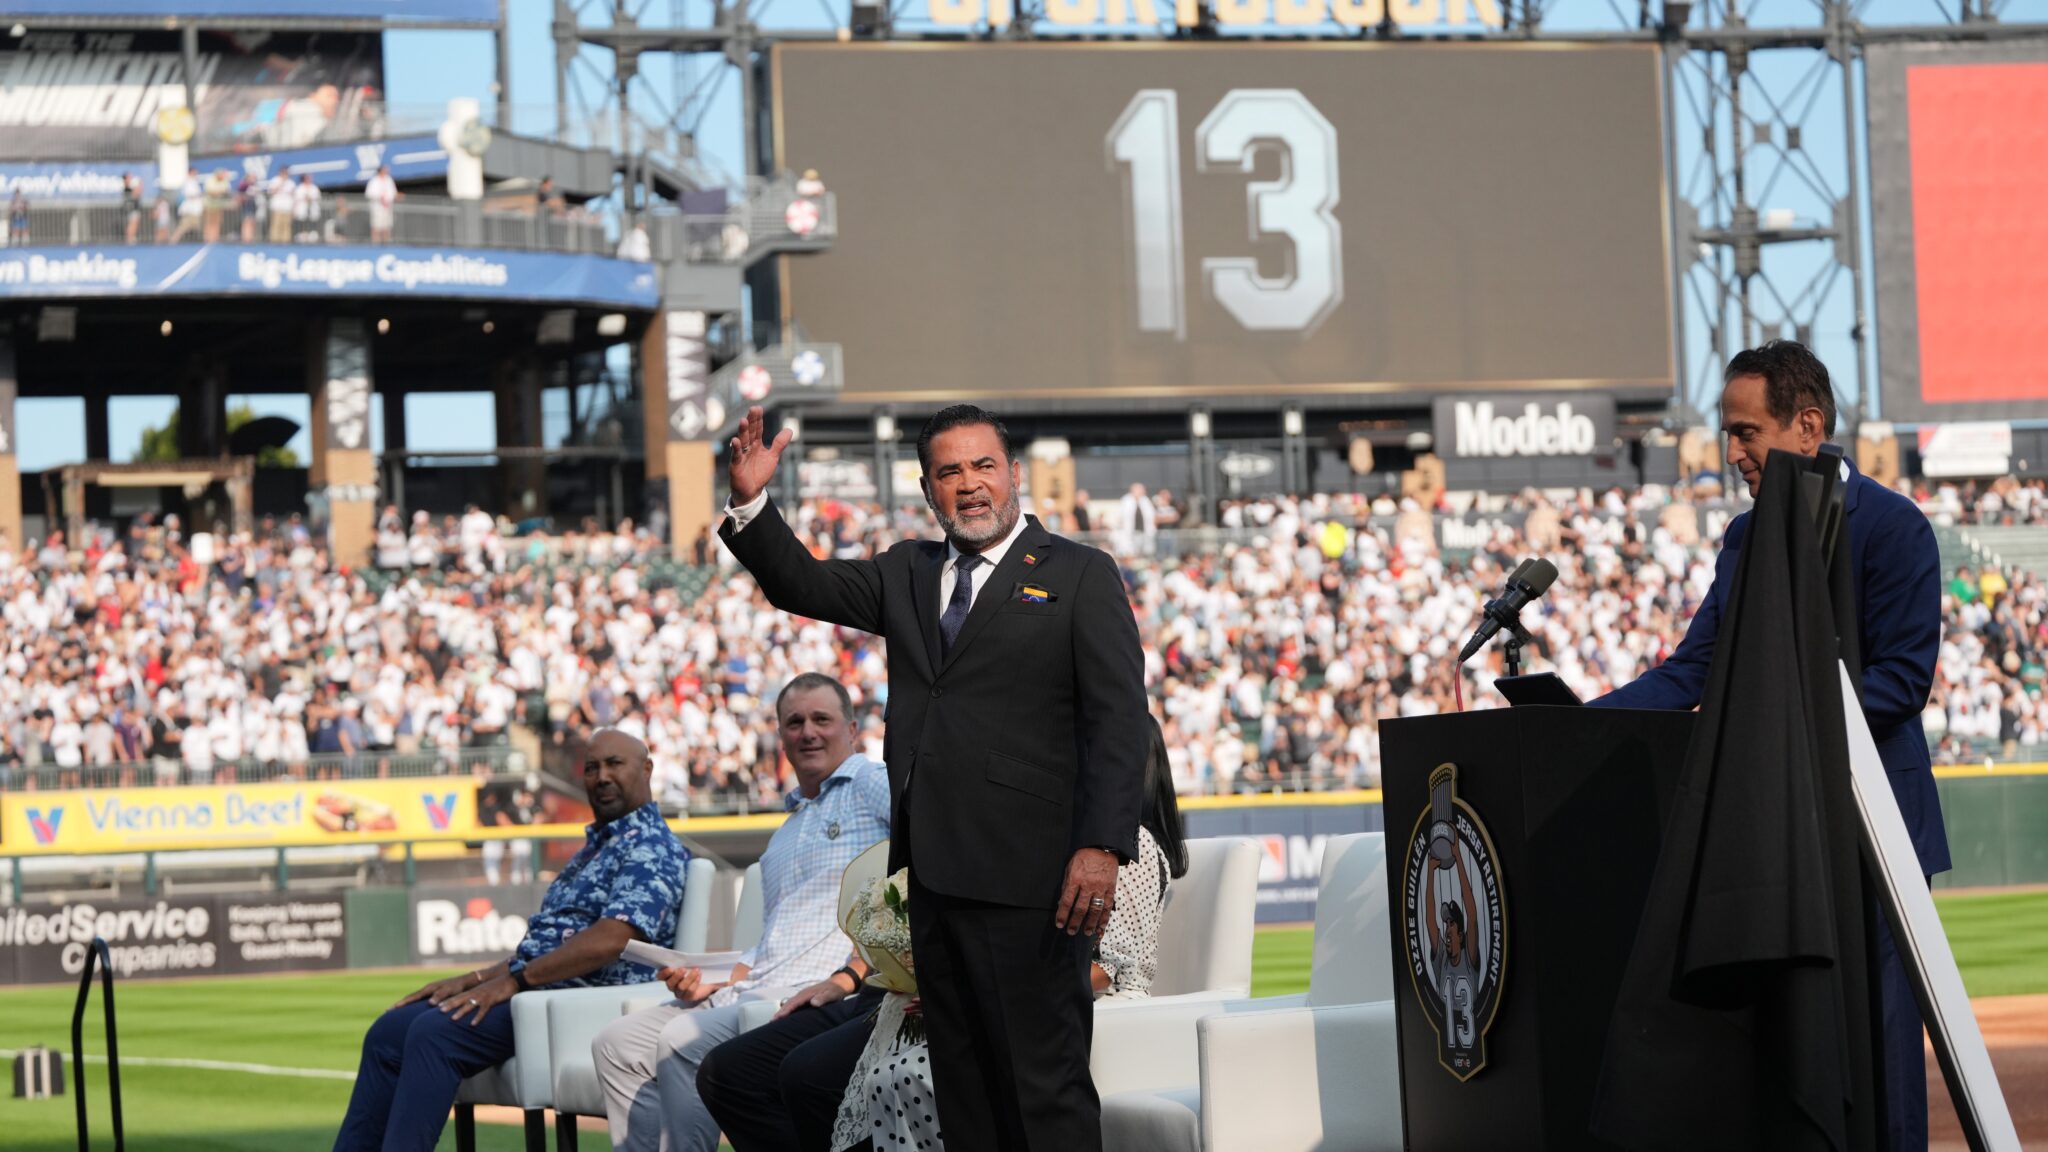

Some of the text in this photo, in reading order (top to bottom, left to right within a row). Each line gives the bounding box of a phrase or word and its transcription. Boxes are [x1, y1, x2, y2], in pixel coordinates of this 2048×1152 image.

[1104, 88, 1344, 341] 13
[29, 253, 138, 289] Banking
[239, 252, 508, 289] Big-League Capabilities
[1455, 401, 1596, 457] Modelo
[87, 791, 304, 830] Vienna Beef
[416, 899, 529, 956] Rate
[1408, 833, 1427, 976] OZZIE GUILLÉN
[1456, 814, 1501, 987] JERSEY RETIREMENT
[1443, 976, 1475, 1048] 13
